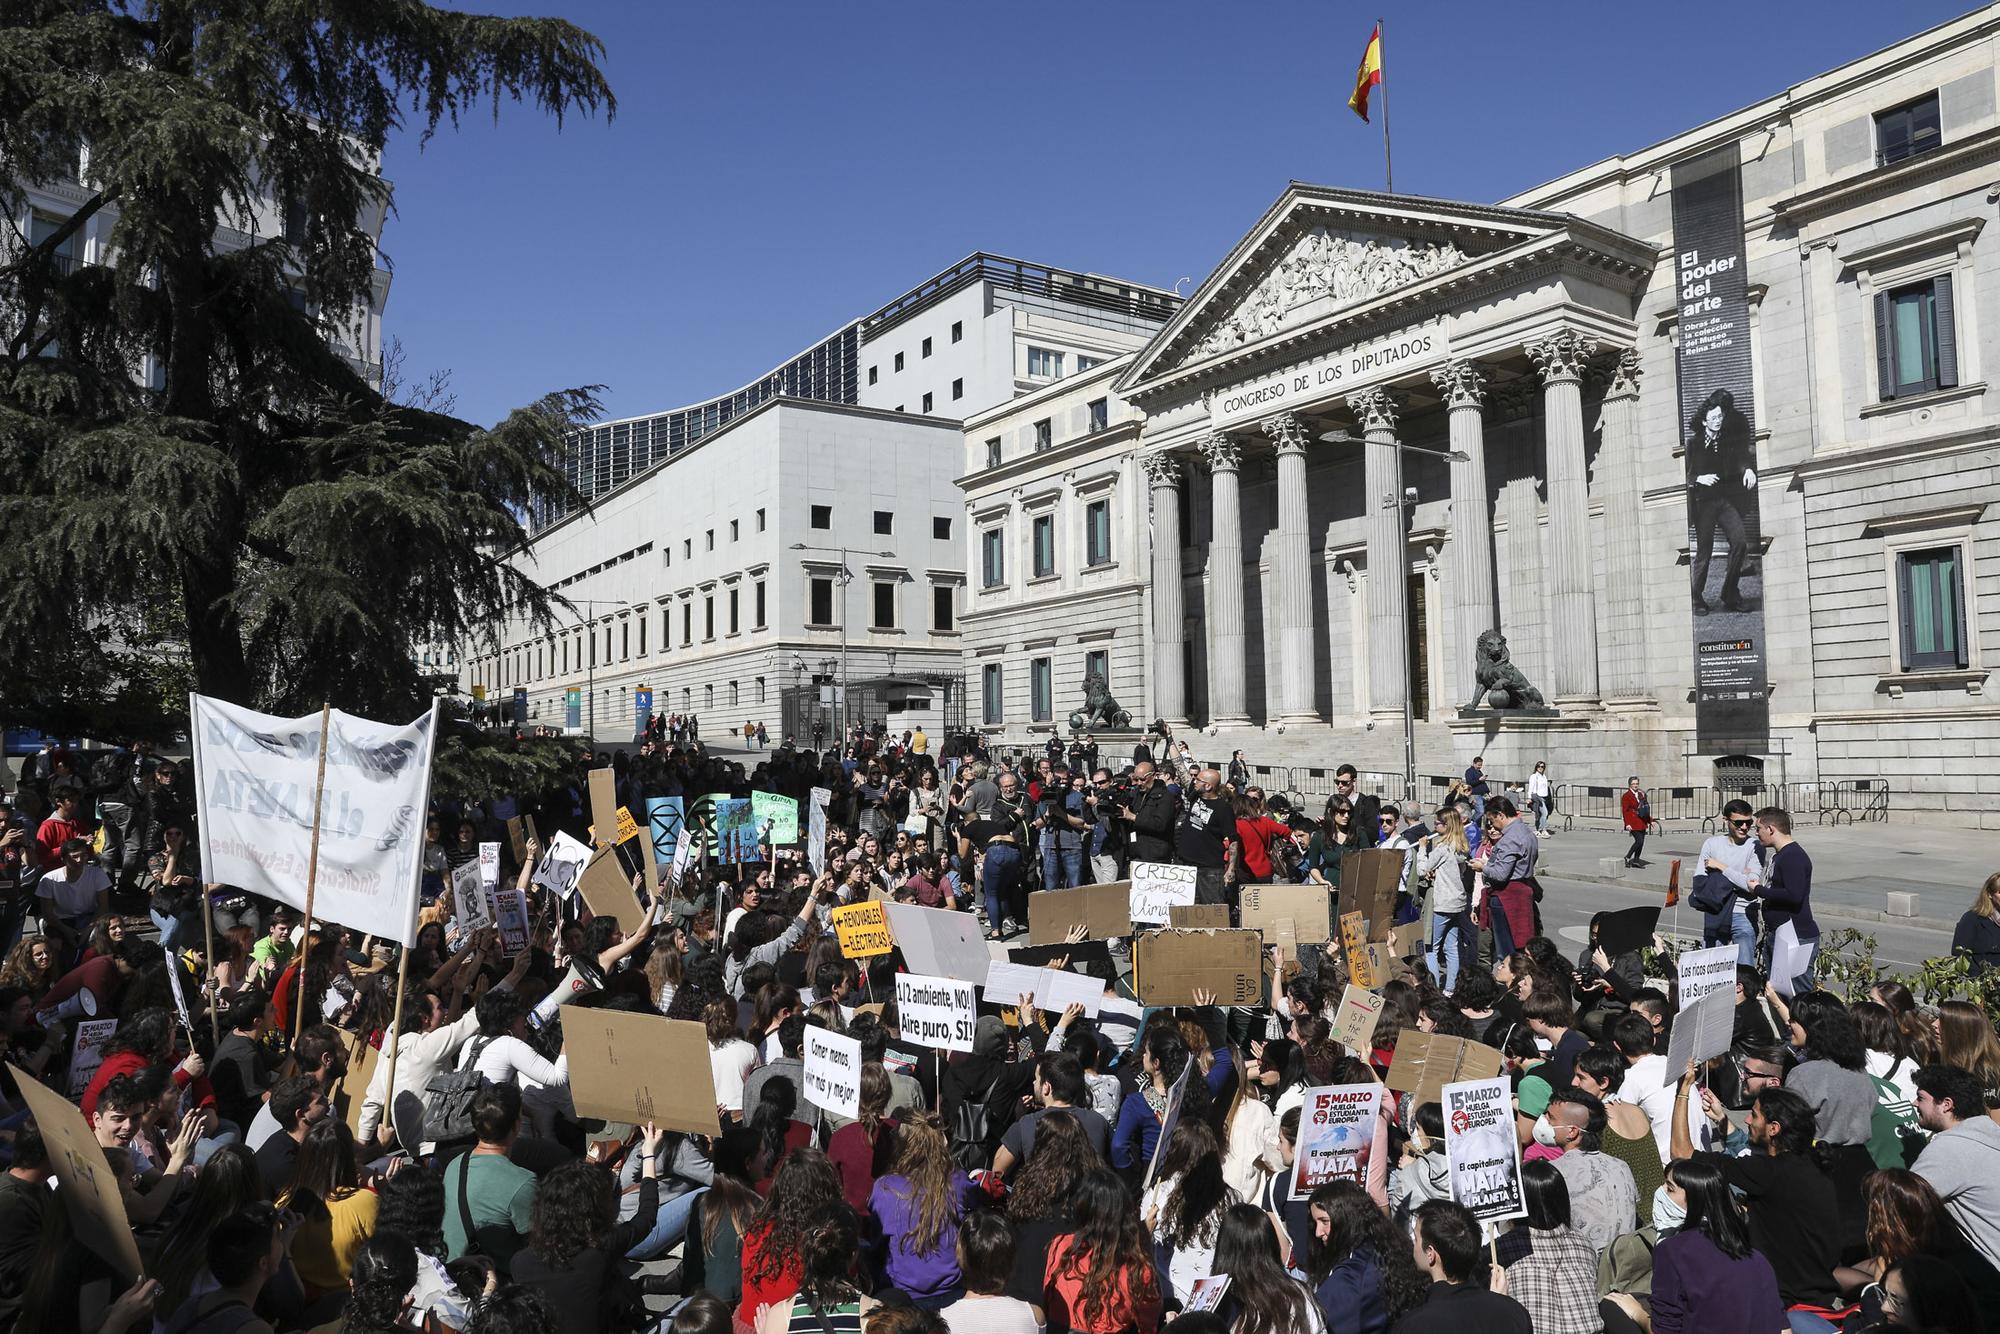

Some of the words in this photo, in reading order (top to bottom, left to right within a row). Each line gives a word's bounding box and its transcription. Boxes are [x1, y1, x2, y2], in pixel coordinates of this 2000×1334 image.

[1681, 250, 1699, 269] El
[1682, 256, 1737, 287] poder
[1682, 279, 1711, 300] del
[1683, 296, 1722, 317] arte
[1684, 321, 1709, 331] Obras
[1684, 332, 1693, 340] la
[1694, 322, 1734, 337] colección
[1685, 338, 1698, 348] del
[1699, 332, 1727, 345] Museo
[1685, 345, 1709, 356] Reina
[1710, 338, 1733, 350] Sofía
[1224, 383, 1286, 413] CONGRESO
[1293, 375, 1309, 393] DE
[1318, 365, 1342, 385] LOS
[1352, 336, 1432, 375] DIPUTADOS
[1700, 640, 1751, 652] constitución
[618, 822, 638, 841] TRICAS
[1133, 863, 1197, 884] CRISIS
[1132, 893, 1175, 918] Climát
[843, 907, 882, 929] RENOVABLES
[1681, 964, 1691, 978] Los
[1692, 962, 1706, 977] ricos
[898, 983, 911, 1001] 1/2
[912, 984, 954, 1013] ambiente,
[954, 988, 971, 1010] NO!
[1681, 988, 1686, 1002] y
[1686, 983, 1692, 998] al
[1693, 983, 1704, 998] Sur
[1351, 1011, 1358, 1022] is
[1358, 1012, 1366, 1024] in
[80, 1025, 90, 1037] 15
[89, 1022, 113, 1031] MARZO
[901, 1014, 920, 1034] Aire
[922, 1019, 952, 1043] puro,
[956, 1013, 974, 1042] SÍ!
[1347, 1023, 1361, 1036] the
[1342, 1034, 1356, 1045] air
[811, 1037, 829, 1057] Comer
[829, 1043, 851, 1071] menos,
[804, 1069, 816, 1088] vivir
[815, 1070, 826, 1093] más
[827, 1082, 833, 1100] y
[833, 1083, 857, 1105] mejor.
[1315, 1094, 1332, 1109] 15
[1331, 1092, 1373, 1104] MARZO
[1330, 1103, 1357, 1111] HUELGA
[1449, 1091, 1465, 1110] 15
[1464, 1086, 1502, 1103] MARZO
[1466, 1102, 1490, 1112] HUELGA
[1328, 1117, 1359, 1125] EUROPEA
[1329, 1109, 1370, 1118] ESTUDIANTIL
[1467, 1108, 1504, 1120] ESTUDIANTIL
[1468, 1119, 1497, 1129] EUROPEA
[1319, 1147, 1360, 1158] capitalismo
[1307, 1156, 1358, 1176] MATA
[1459, 1163, 1466, 1172] El
[1467, 1158, 1505, 1171] capitalismo
[1306, 1176, 1316, 1186] el
[1460, 1170, 1509, 1196] MATA
[1463, 1197, 1471, 1208] el
[1472, 1190, 1510, 1207] PLANETA
